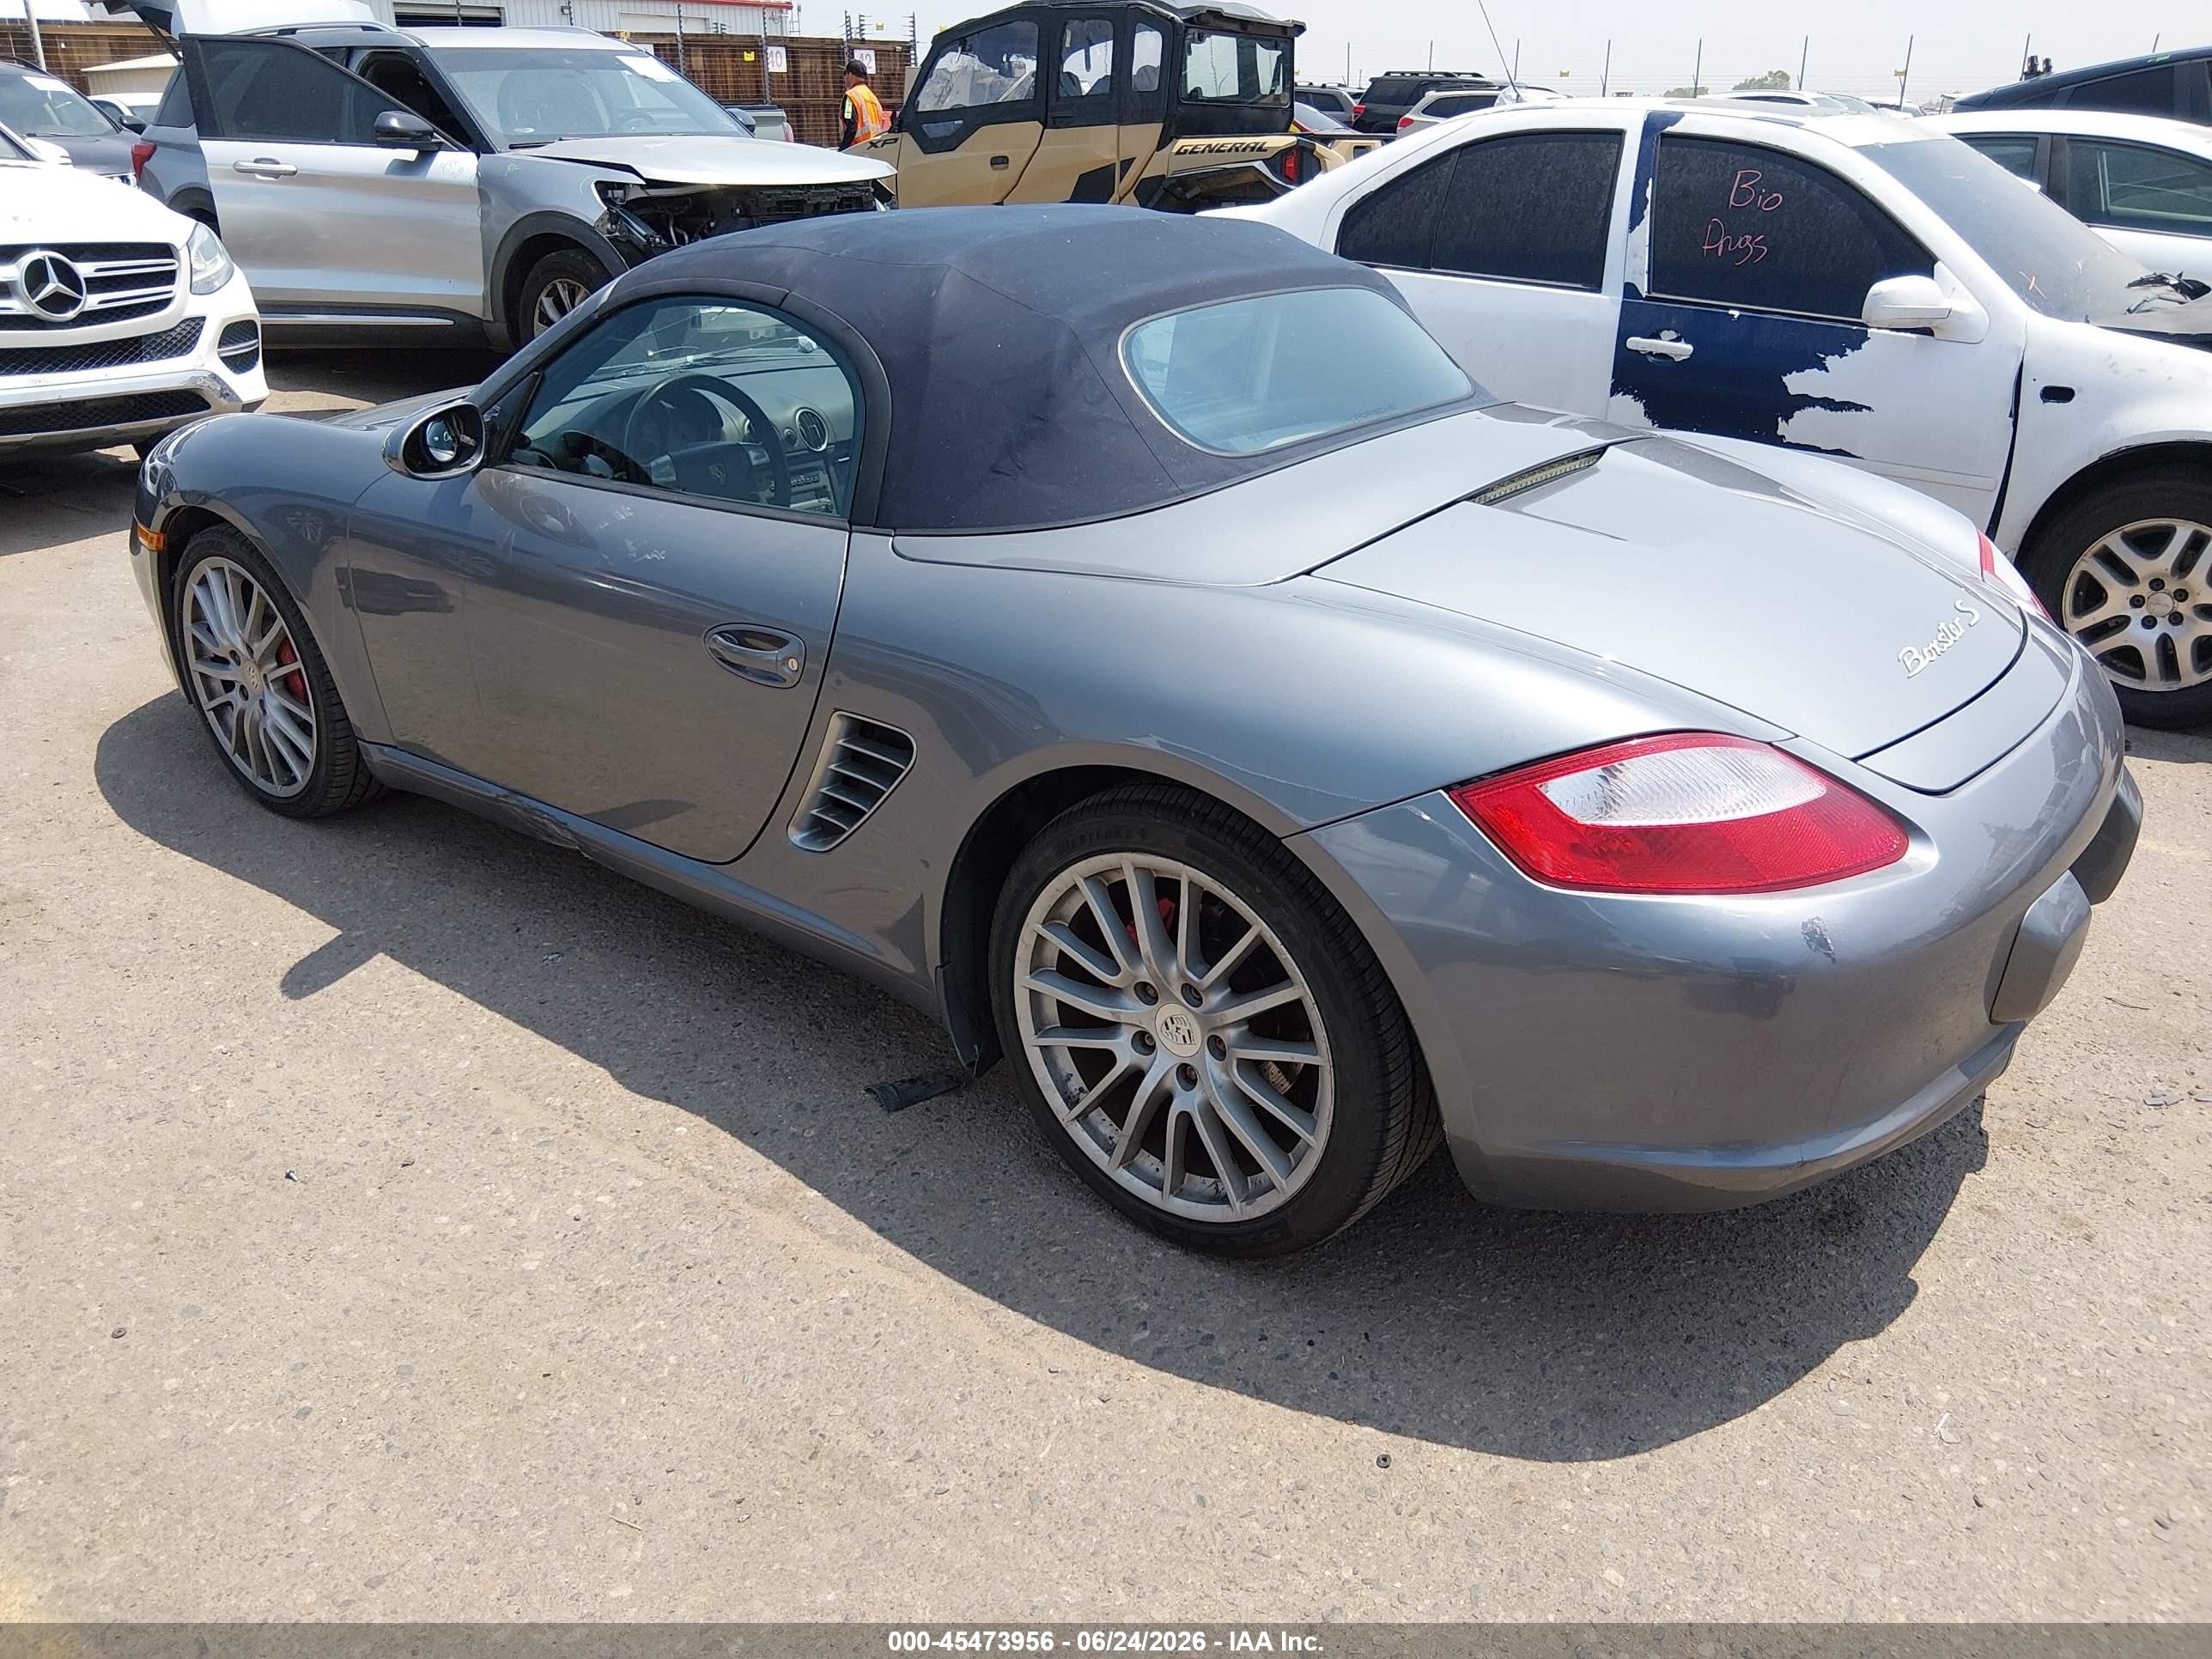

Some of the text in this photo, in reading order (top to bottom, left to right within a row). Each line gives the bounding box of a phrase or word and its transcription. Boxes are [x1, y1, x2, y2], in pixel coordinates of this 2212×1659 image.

[769, 50, 782, 68] 40
[866, 137, 899, 150] XP
[1175, 141, 1268, 155] GENERAL
[1729, 170, 1784, 211] Bio
[1897, 599, 1980, 679] Boxster S
